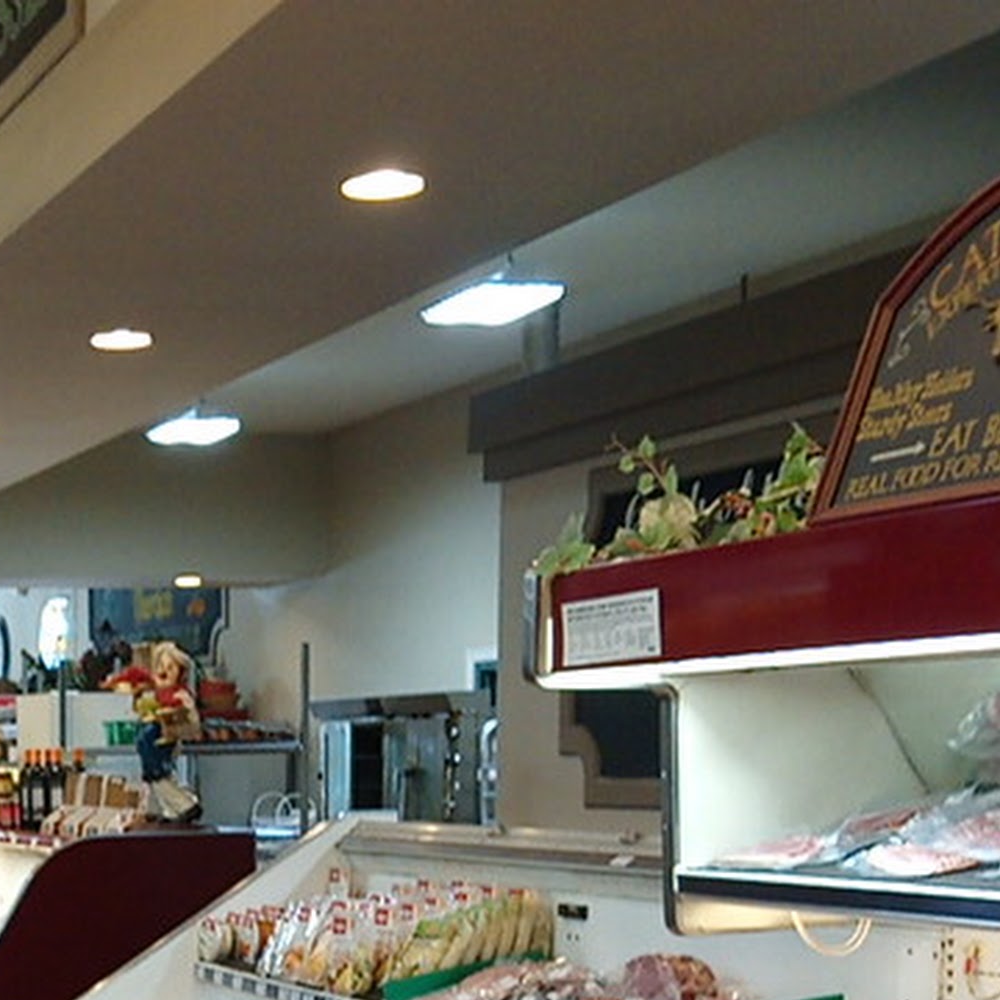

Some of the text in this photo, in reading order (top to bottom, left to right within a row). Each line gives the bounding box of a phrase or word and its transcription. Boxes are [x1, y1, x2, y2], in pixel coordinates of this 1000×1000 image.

[928, 419, 979, 458] EAT
[844, 470, 888, 500] REAL
[891, 462, 940, 490] FOOD
[939, 453, 981, 482] FOR
